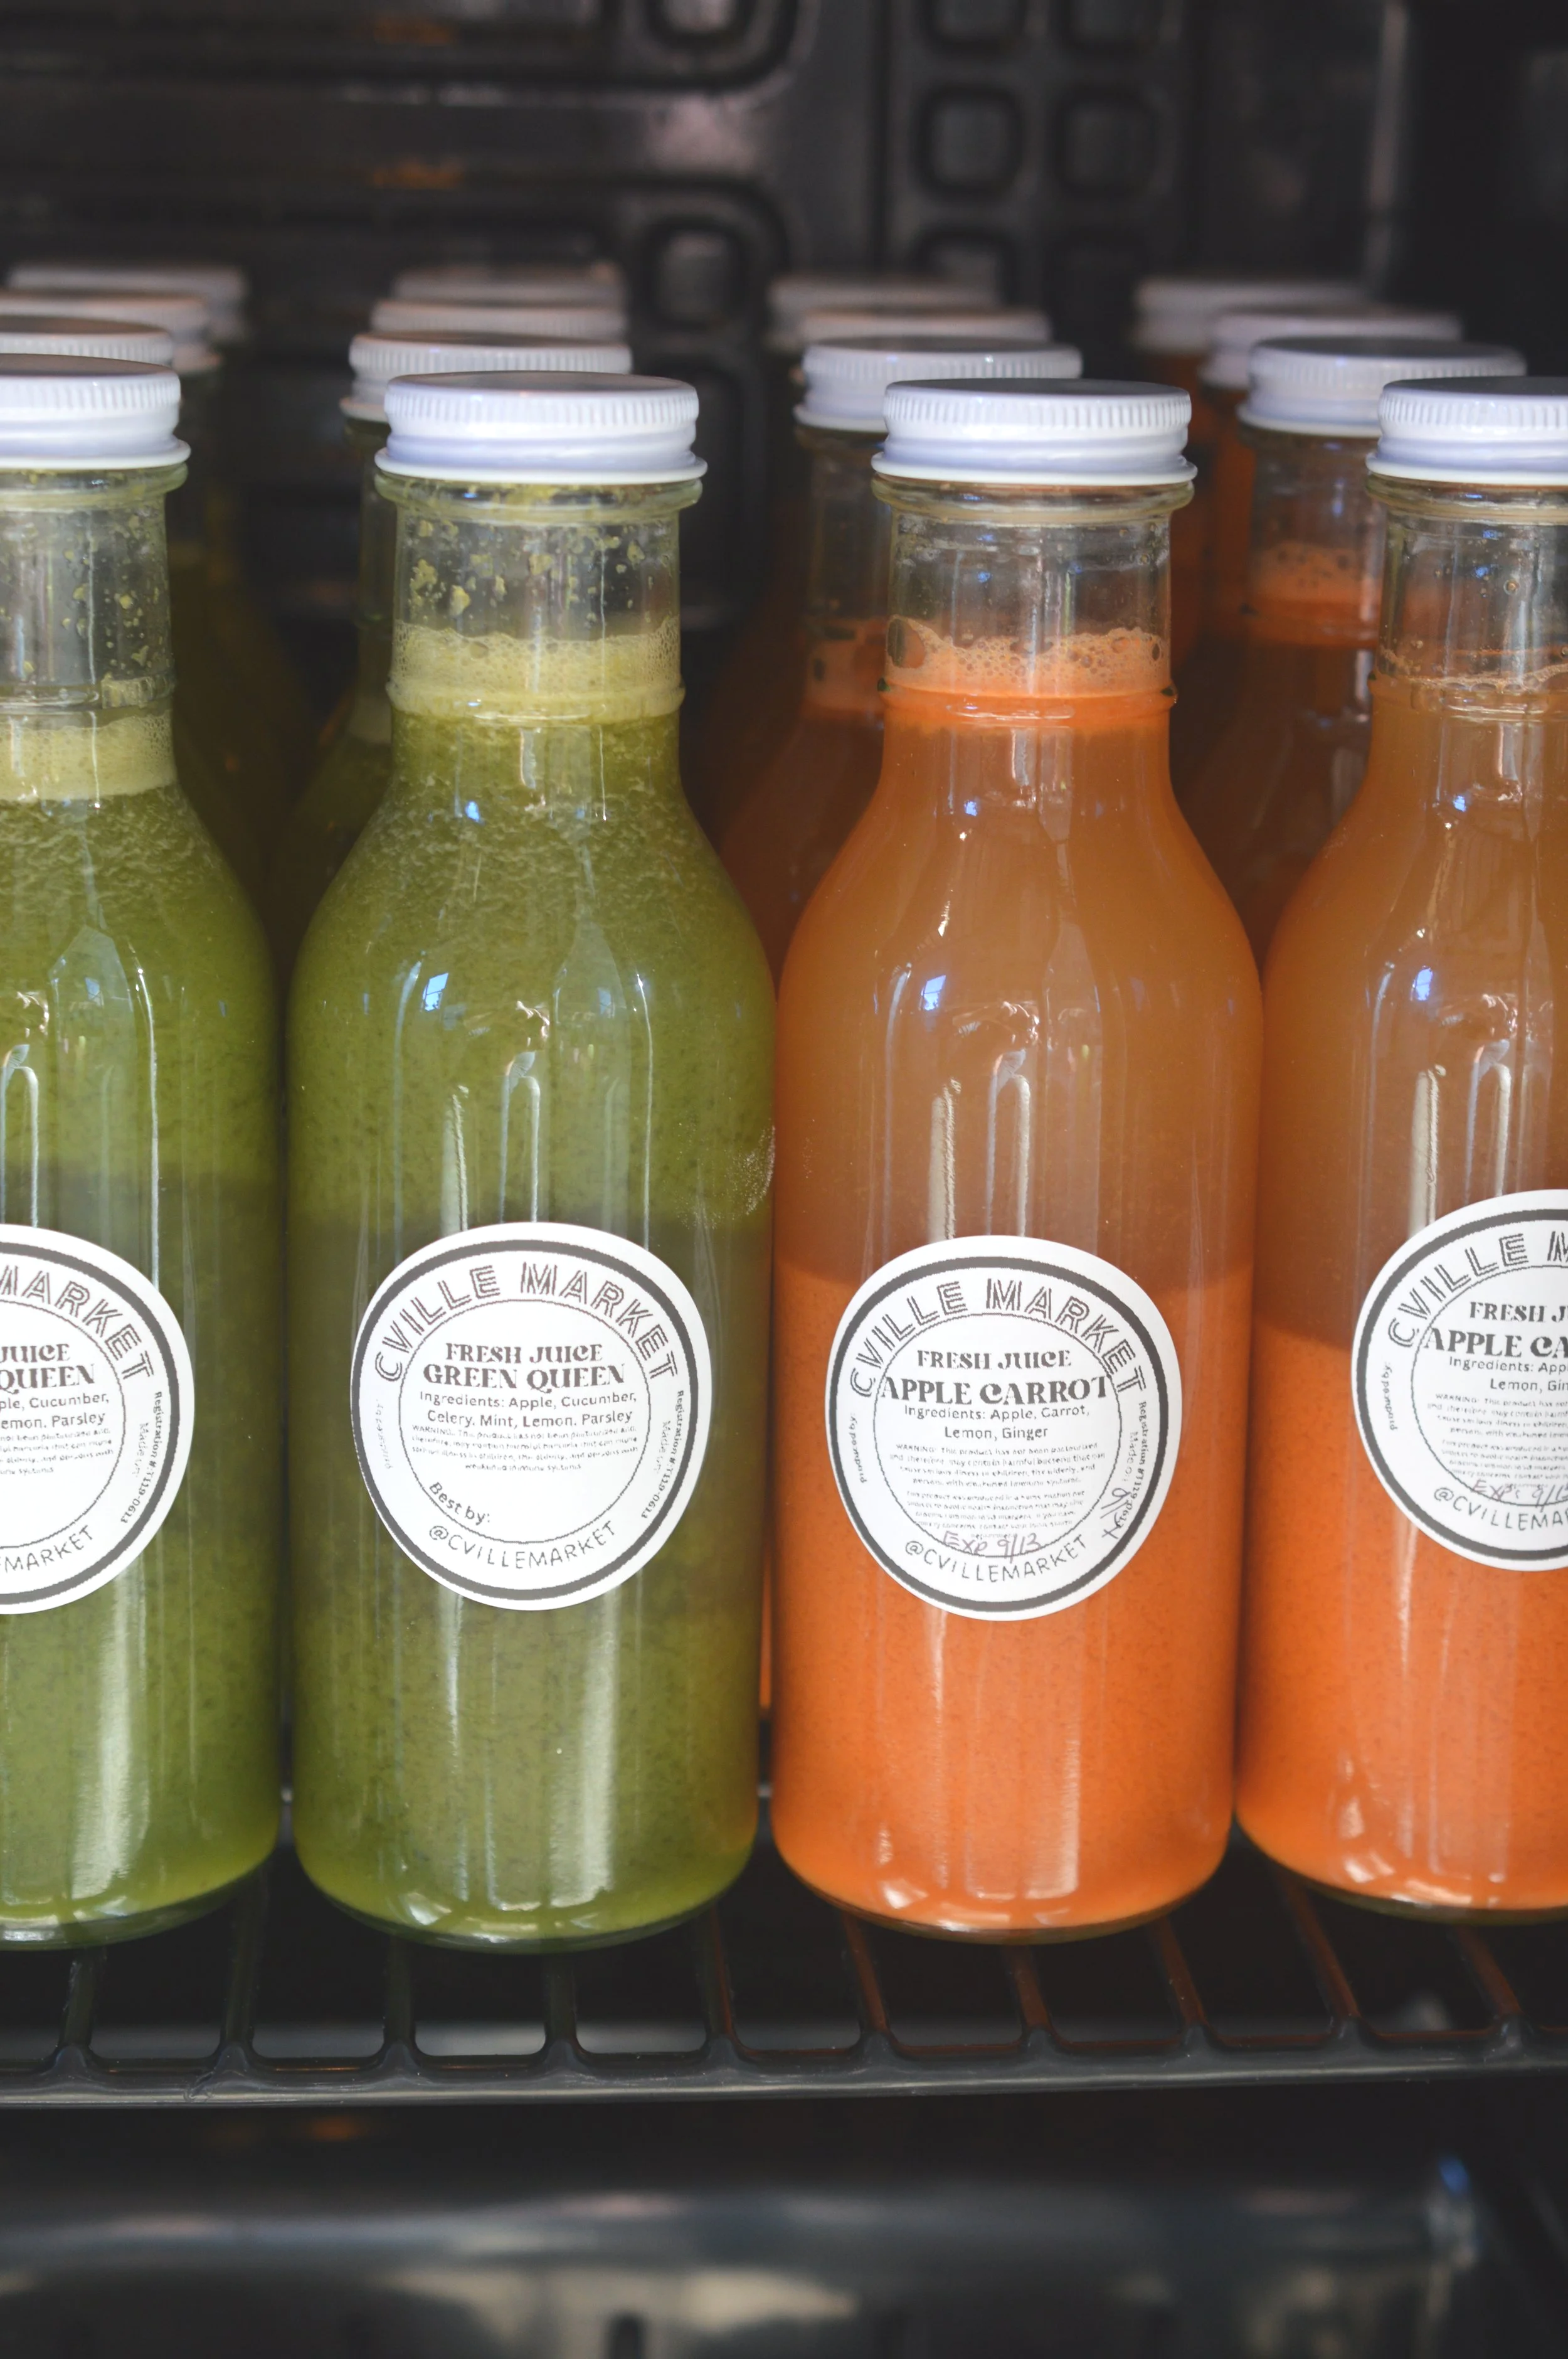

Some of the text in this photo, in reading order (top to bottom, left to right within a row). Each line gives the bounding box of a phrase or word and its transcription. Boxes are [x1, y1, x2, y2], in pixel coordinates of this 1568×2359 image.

[1388, 1233, 1529, 1348] CVILLE
[375, 1261, 679, 1383] CVILLE MARKET
[1470, 1301, 1547, 1323] FRESH
[850, 1277, 1148, 1398] CVILLE MARKET
[1422, 1327, 1522, 1358] APPLE
[0, 1343, 70, 1363] JUICE
[445, 1343, 603, 1365] FRESH JUICE
[916, 1350, 1072, 1370] FRESH JUICE
[1449, 1356, 1534, 1373] Ingredients:
[0, 1363, 95, 1395] QUEEN
[423, 1363, 625, 1393] GREEN QUEEN
[881, 1375, 1107, 1405] APPLE CARROT
[1490, 1378, 1542, 1394] Lemon,
[29, 1392, 110, 1409] Cucumber,
[420, 1391, 637, 1411] Ingredients: Apple, Cucumber,
[904, 1405, 986, 1420] Ingredients:
[1041, 1405, 1089, 1418] Carrot,
[51, 1412, 105, 1426] Parsley
[151, 1391, 164, 1457] Registration
[480, 1414, 518, 1430] Mint,
[581, 1410, 633, 1424] Parsley
[670, 1390, 685, 1454] Registration
[945, 1426, 1049, 1441] Lemon, Ginger
[1138, 1400, 1148, 1465] Registration
[429, 1481, 490, 1526] Best by:
[1434, 1487, 1568, 1531] @CVILLEMA
[0, 1525, 93, 1573] MARKET
[429, 1520, 615, 1570] @CVILLEMARKET
[905, 1533, 1086, 1583] @CVILLEMARKET
